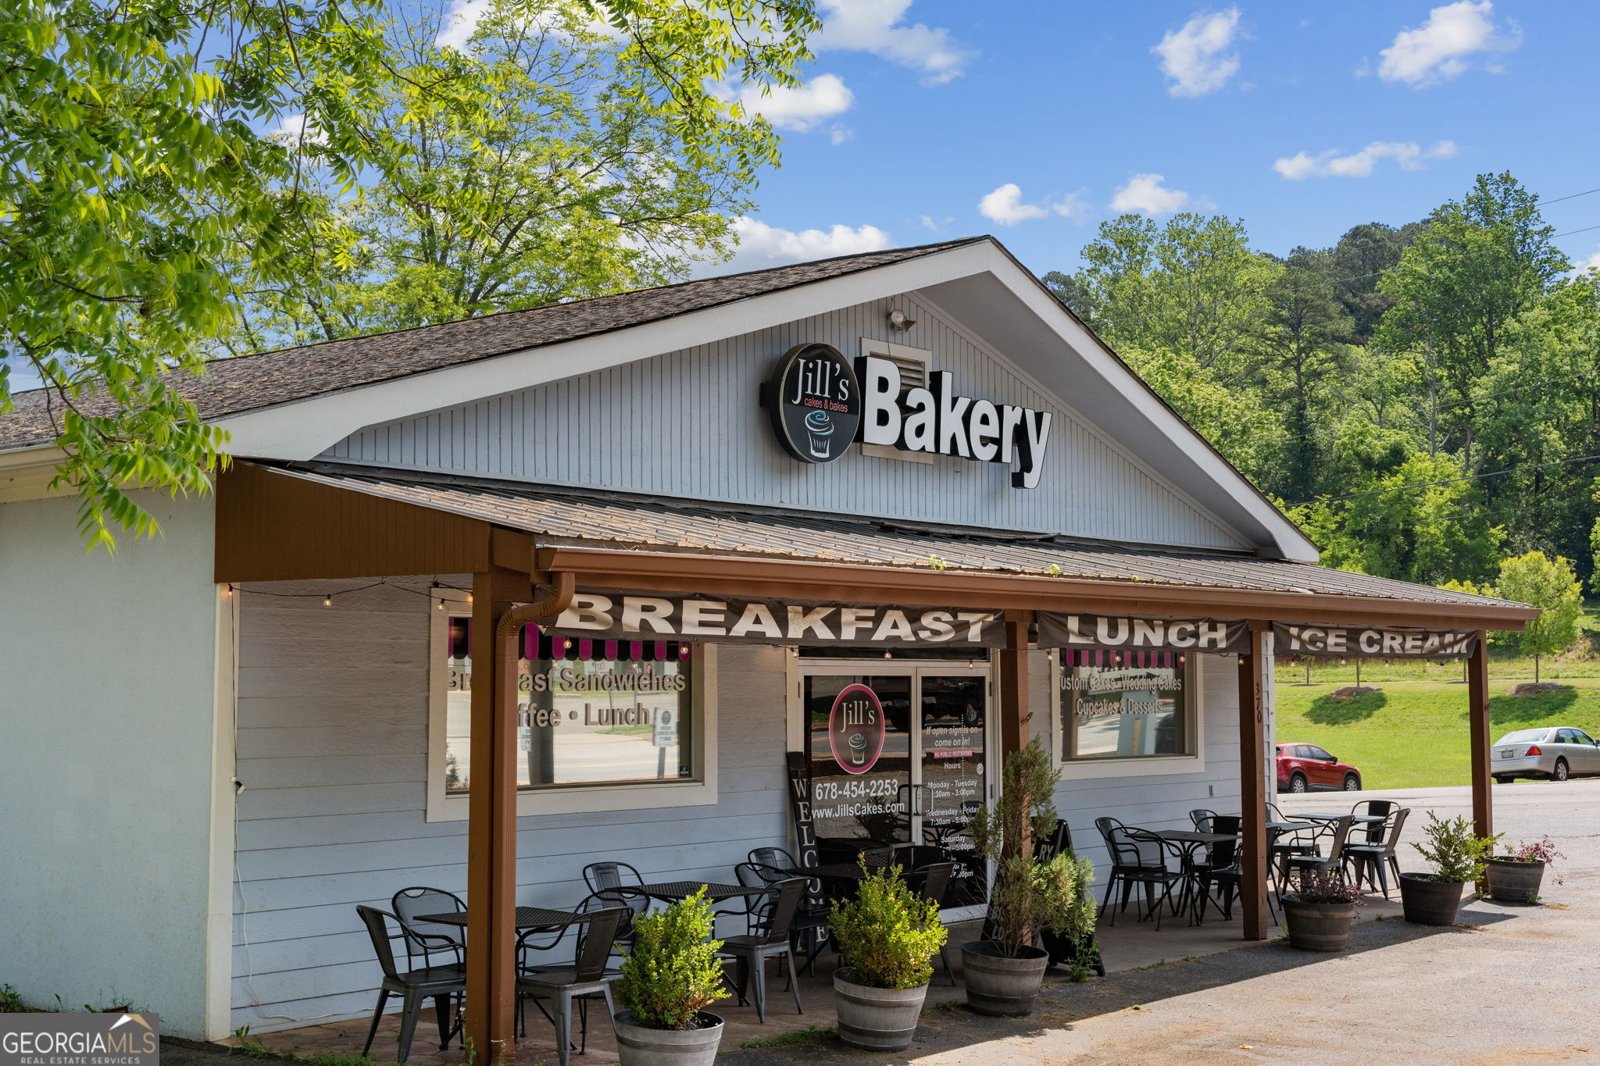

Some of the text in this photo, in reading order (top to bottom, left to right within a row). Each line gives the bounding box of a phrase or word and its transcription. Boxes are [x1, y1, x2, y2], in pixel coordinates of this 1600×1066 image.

[791, 358, 850, 405] Jill's
[804, 397, 848, 413] cakes & bakes
[860, 356, 1053, 489] Bakery
[555, 594, 996, 643] BREAKFAST
[1067, 615, 1227, 648] LUNCH
[1289, 627, 1468, 654] ICE CREAM
[560, 666, 686, 693] Sandwiches
[1060, 673, 1088, 690] ustom
[584, 702, 650, 727] Lunch
[840, 700, 875, 733] Jill's
[1076, 697, 1118, 719] Cupcakes
[1126, 697, 1163, 715] Desserts
[932, 727, 948, 736] open
[815, 778, 899, 801] 678-454-2253
[954, 780, 978, 788] Tuesday
[812, 802, 904, 819] www.JillsCakes.com
[940, 835, 966, 844] Saturday
